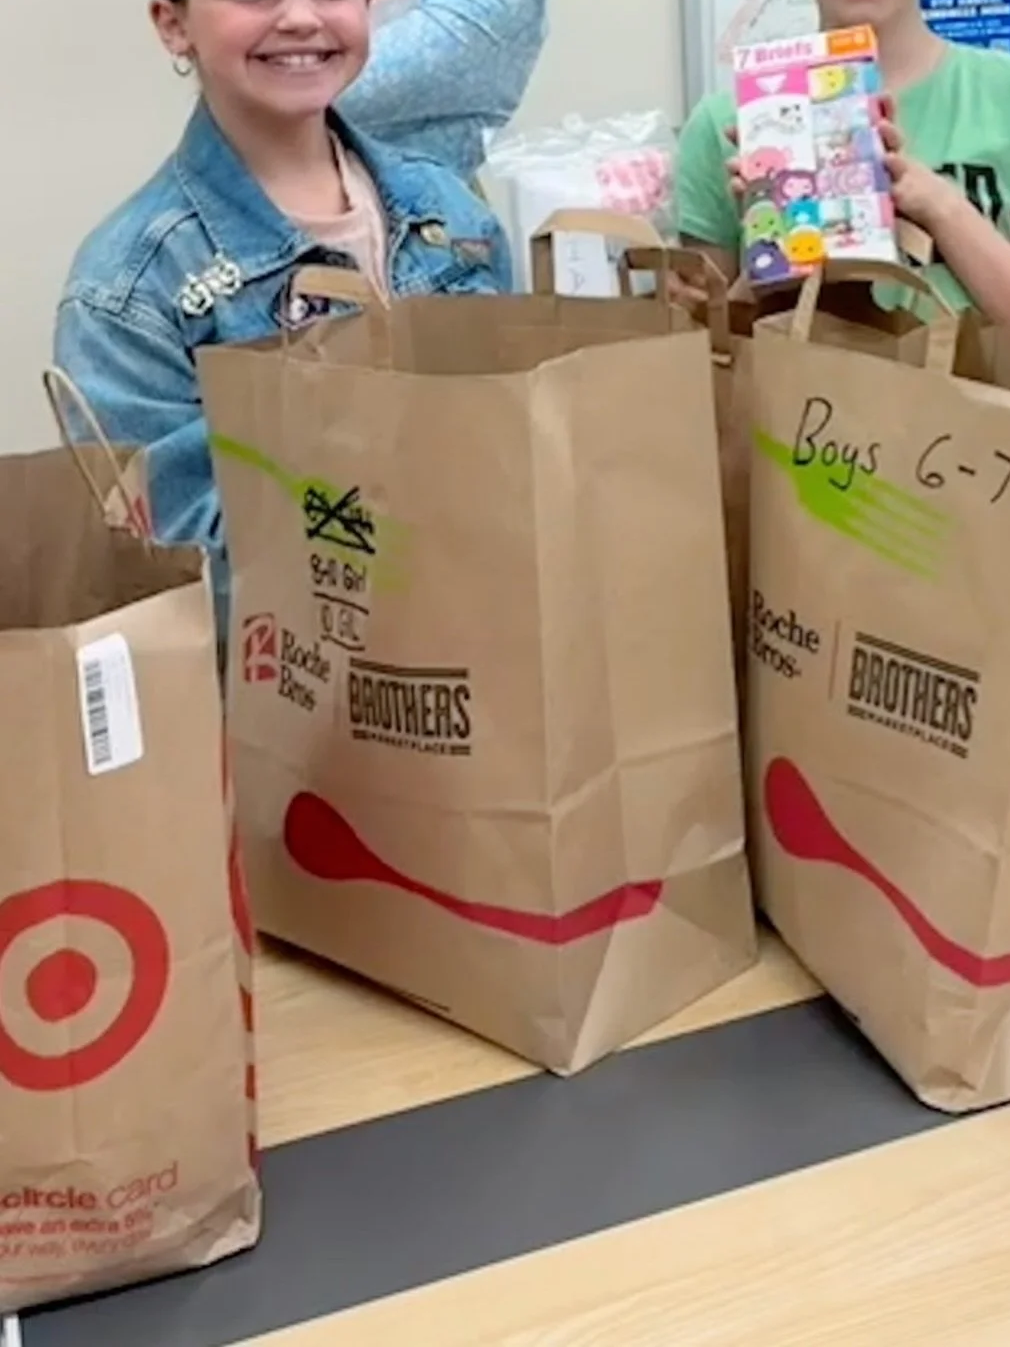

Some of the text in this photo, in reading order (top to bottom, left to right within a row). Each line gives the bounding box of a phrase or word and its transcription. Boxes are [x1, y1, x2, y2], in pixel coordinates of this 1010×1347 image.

[736, 41, 813, 70] 7 Briefs
[791, 396, 882, 492] Boys
[752, 588, 821, 655] Roche
[279, 627, 332, 683] Roche
[347, 671, 472, 740] BROTHERS
[847, 646, 979, 742] BROTHERS
[371, 730, 447, 755] MARKETPLACE
[865, 711, 953, 752] MARKETPLACE
[1, 1160, 180, 1211] circle card
